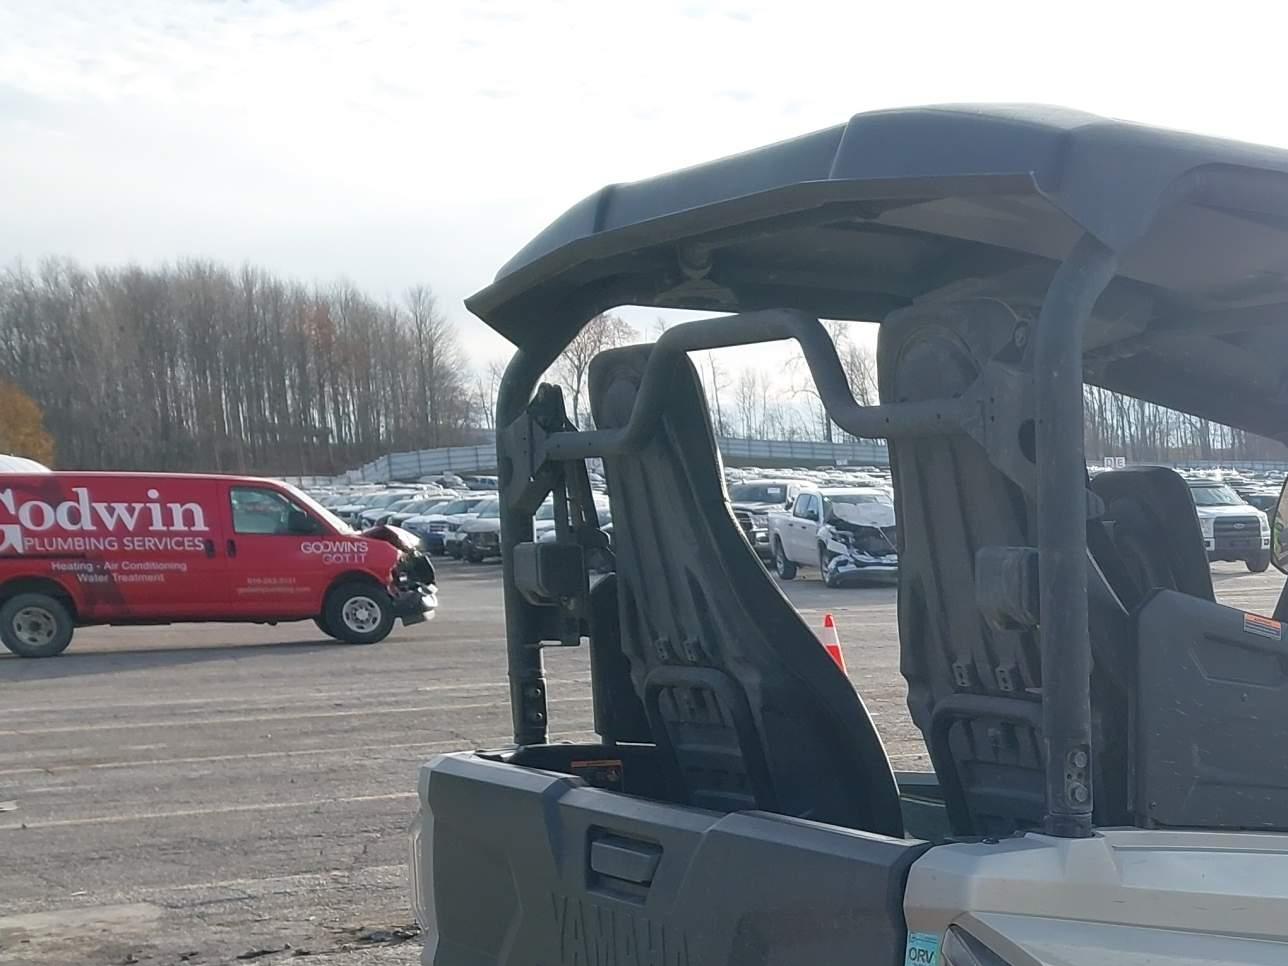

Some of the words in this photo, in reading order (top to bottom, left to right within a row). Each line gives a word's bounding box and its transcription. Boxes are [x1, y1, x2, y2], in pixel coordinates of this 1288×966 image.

[23, 537, 118, 551] PLUMBING
[123, 537, 205, 551] SERVICES
[323, 553, 351, 565] GOT
[51, 561, 94, 572] Heating
[104, 561, 119, 571] Air
[121, 561, 187, 572] Conditioning
[77, 573, 109, 583] Water
[112, 573, 166, 584] Treatment
[909, 947, 935, 964] ORV
